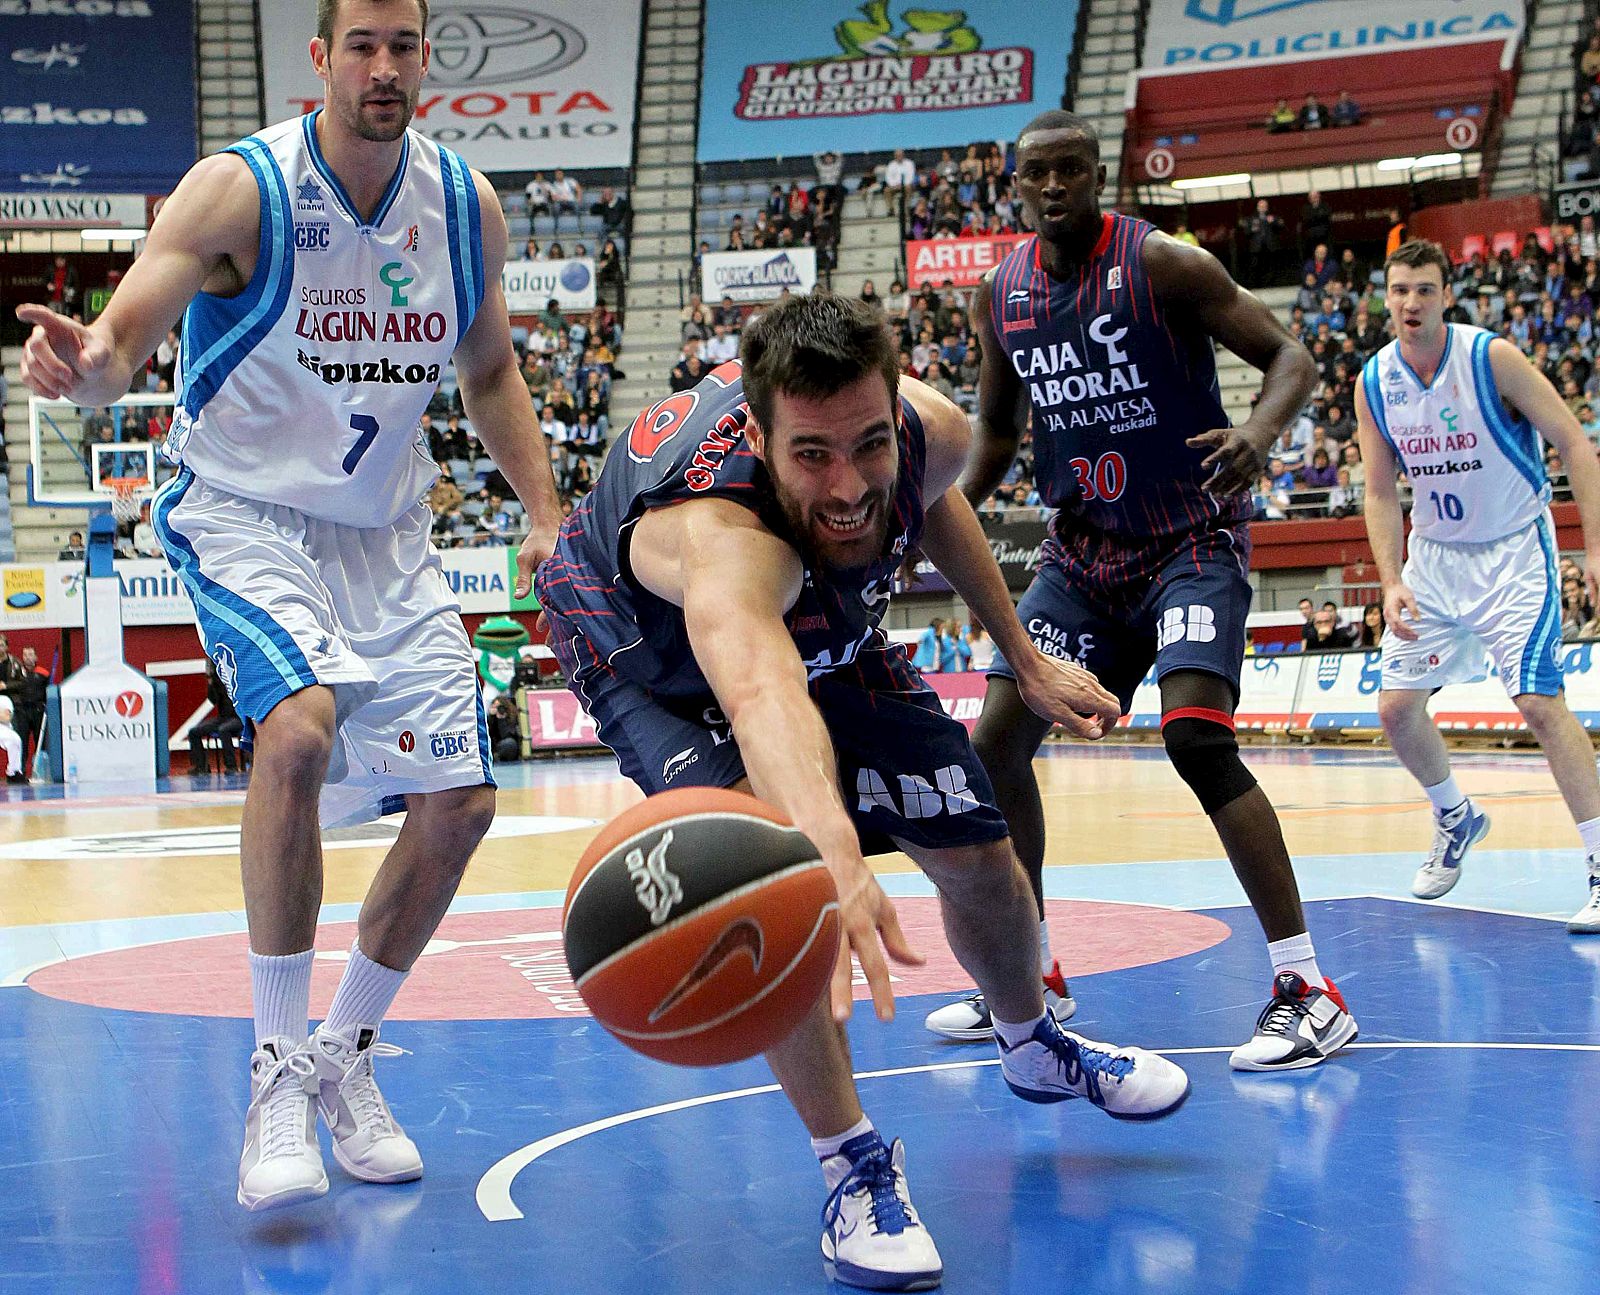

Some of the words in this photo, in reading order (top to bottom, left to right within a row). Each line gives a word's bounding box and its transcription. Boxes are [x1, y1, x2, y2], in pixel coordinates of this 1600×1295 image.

[1163, 12, 1514, 65] POLICLINICA
[752, 57, 914, 87] LAGUN
[924, 49, 1025, 79] ARO
[750, 85, 816, 102] SAN
[821, 71, 1023, 100] SEBASTIAN
[0, 103, 148, 125] zkoa
[286, 90, 613, 119] TYOTA
[743, 97, 896, 117] GIPUZKOA
[902, 88, 1020, 110] BASKET
[426, 120, 618, 142] oAuto
[42, 198, 112, 218] VASCO
[297, 202, 325, 211] luanvi
[294, 227, 330, 249] GBC
[295, 308, 376, 342] LAGUN
[382, 311, 447, 342] ARO
[1012, 341, 1083, 379] CAJA
[1030, 363, 1149, 408] ABORAL
[1069, 396, 1156, 429] ALAVESA
[1109, 412, 1158, 435] euskadi
[342, 413, 379, 476] 7
[684, 402, 750, 492] ERIO
[1400, 437, 1440, 456] AGUN
[1444, 432, 1478, 452] ARO
[1069, 451, 1127, 503] 30
[1410, 459, 1483, 478] puzkoa
[1430, 491, 1464, 521] 10
[1028, 618, 1068, 648] CAJA
[67, 721, 151, 741] EUSKADI
[430, 735, 469, 758] GBC
[856, 764, 981, 819] ABB
